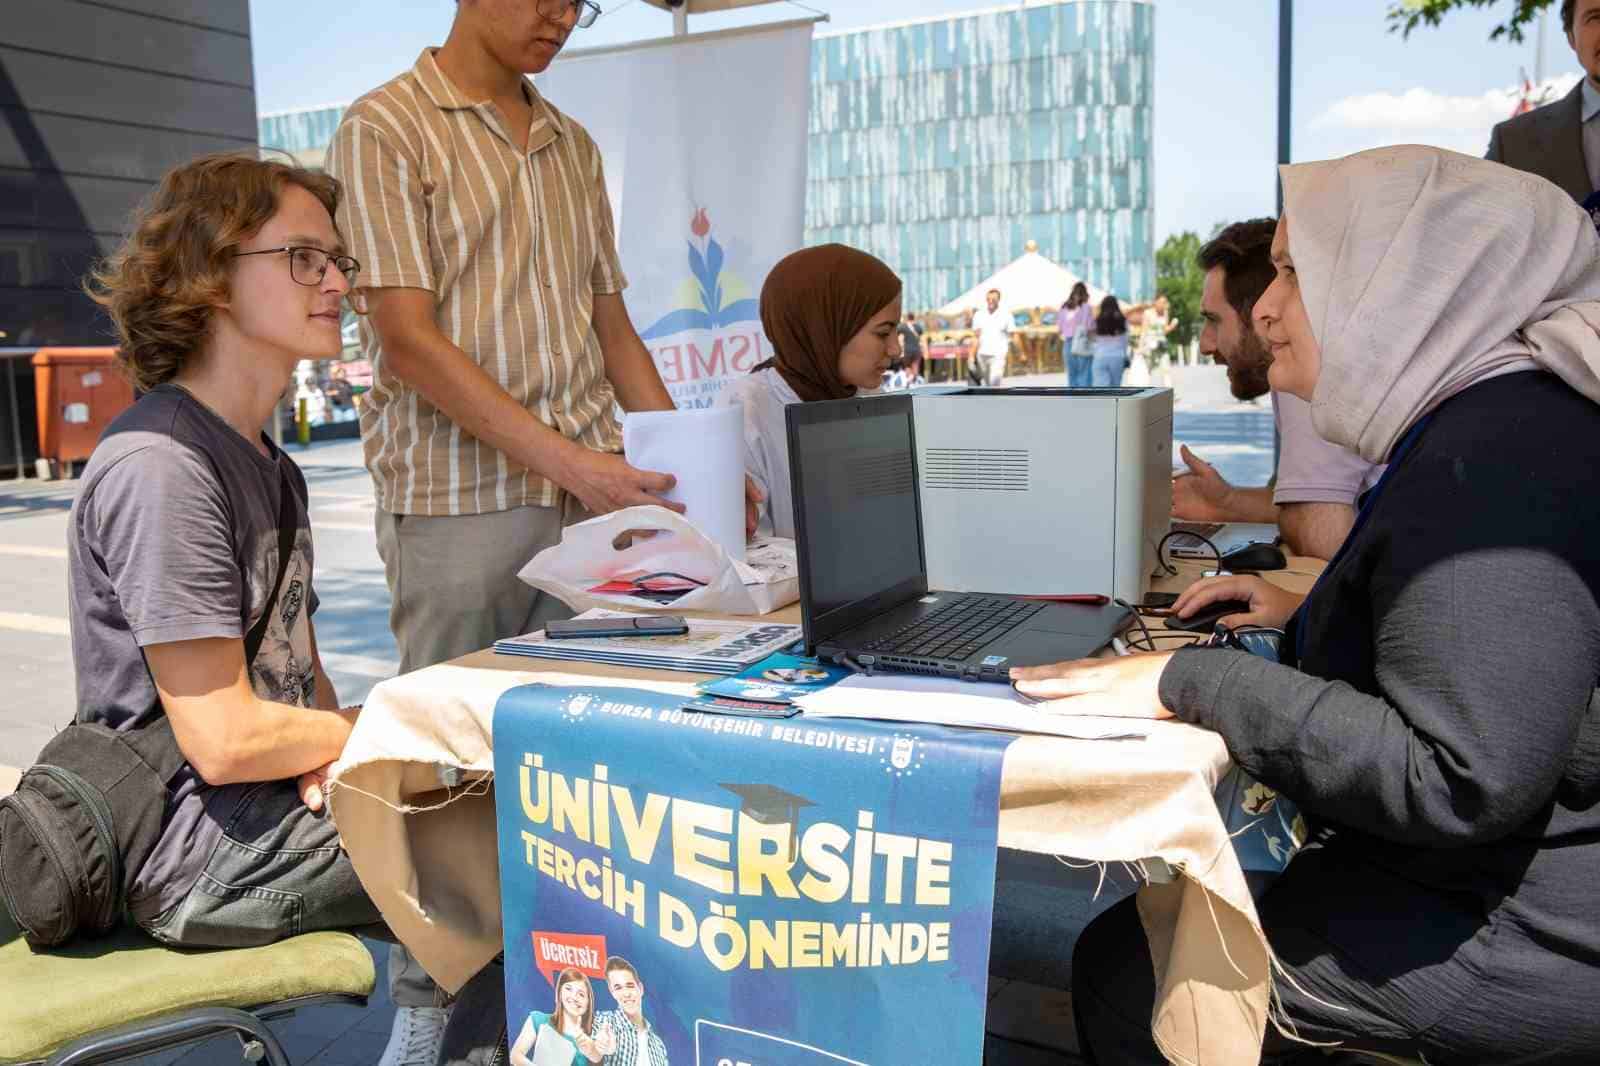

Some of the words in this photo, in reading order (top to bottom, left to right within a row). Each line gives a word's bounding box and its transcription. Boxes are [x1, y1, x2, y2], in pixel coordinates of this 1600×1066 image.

[601, 701, 651, 721] BURSA
[659, 709, 763, 738] BÜYÜKŞEHİR
[771, 724, 875, 756] BELEDİYESİ
[519, 752, 953, 906] ÜNİVERSİTE
[521, 830, 645, 928] TERCİH
[659, 891, 951, 971] DÖNEMİNDE
[540, 935, 600, 970] ÜCRETSİZ
